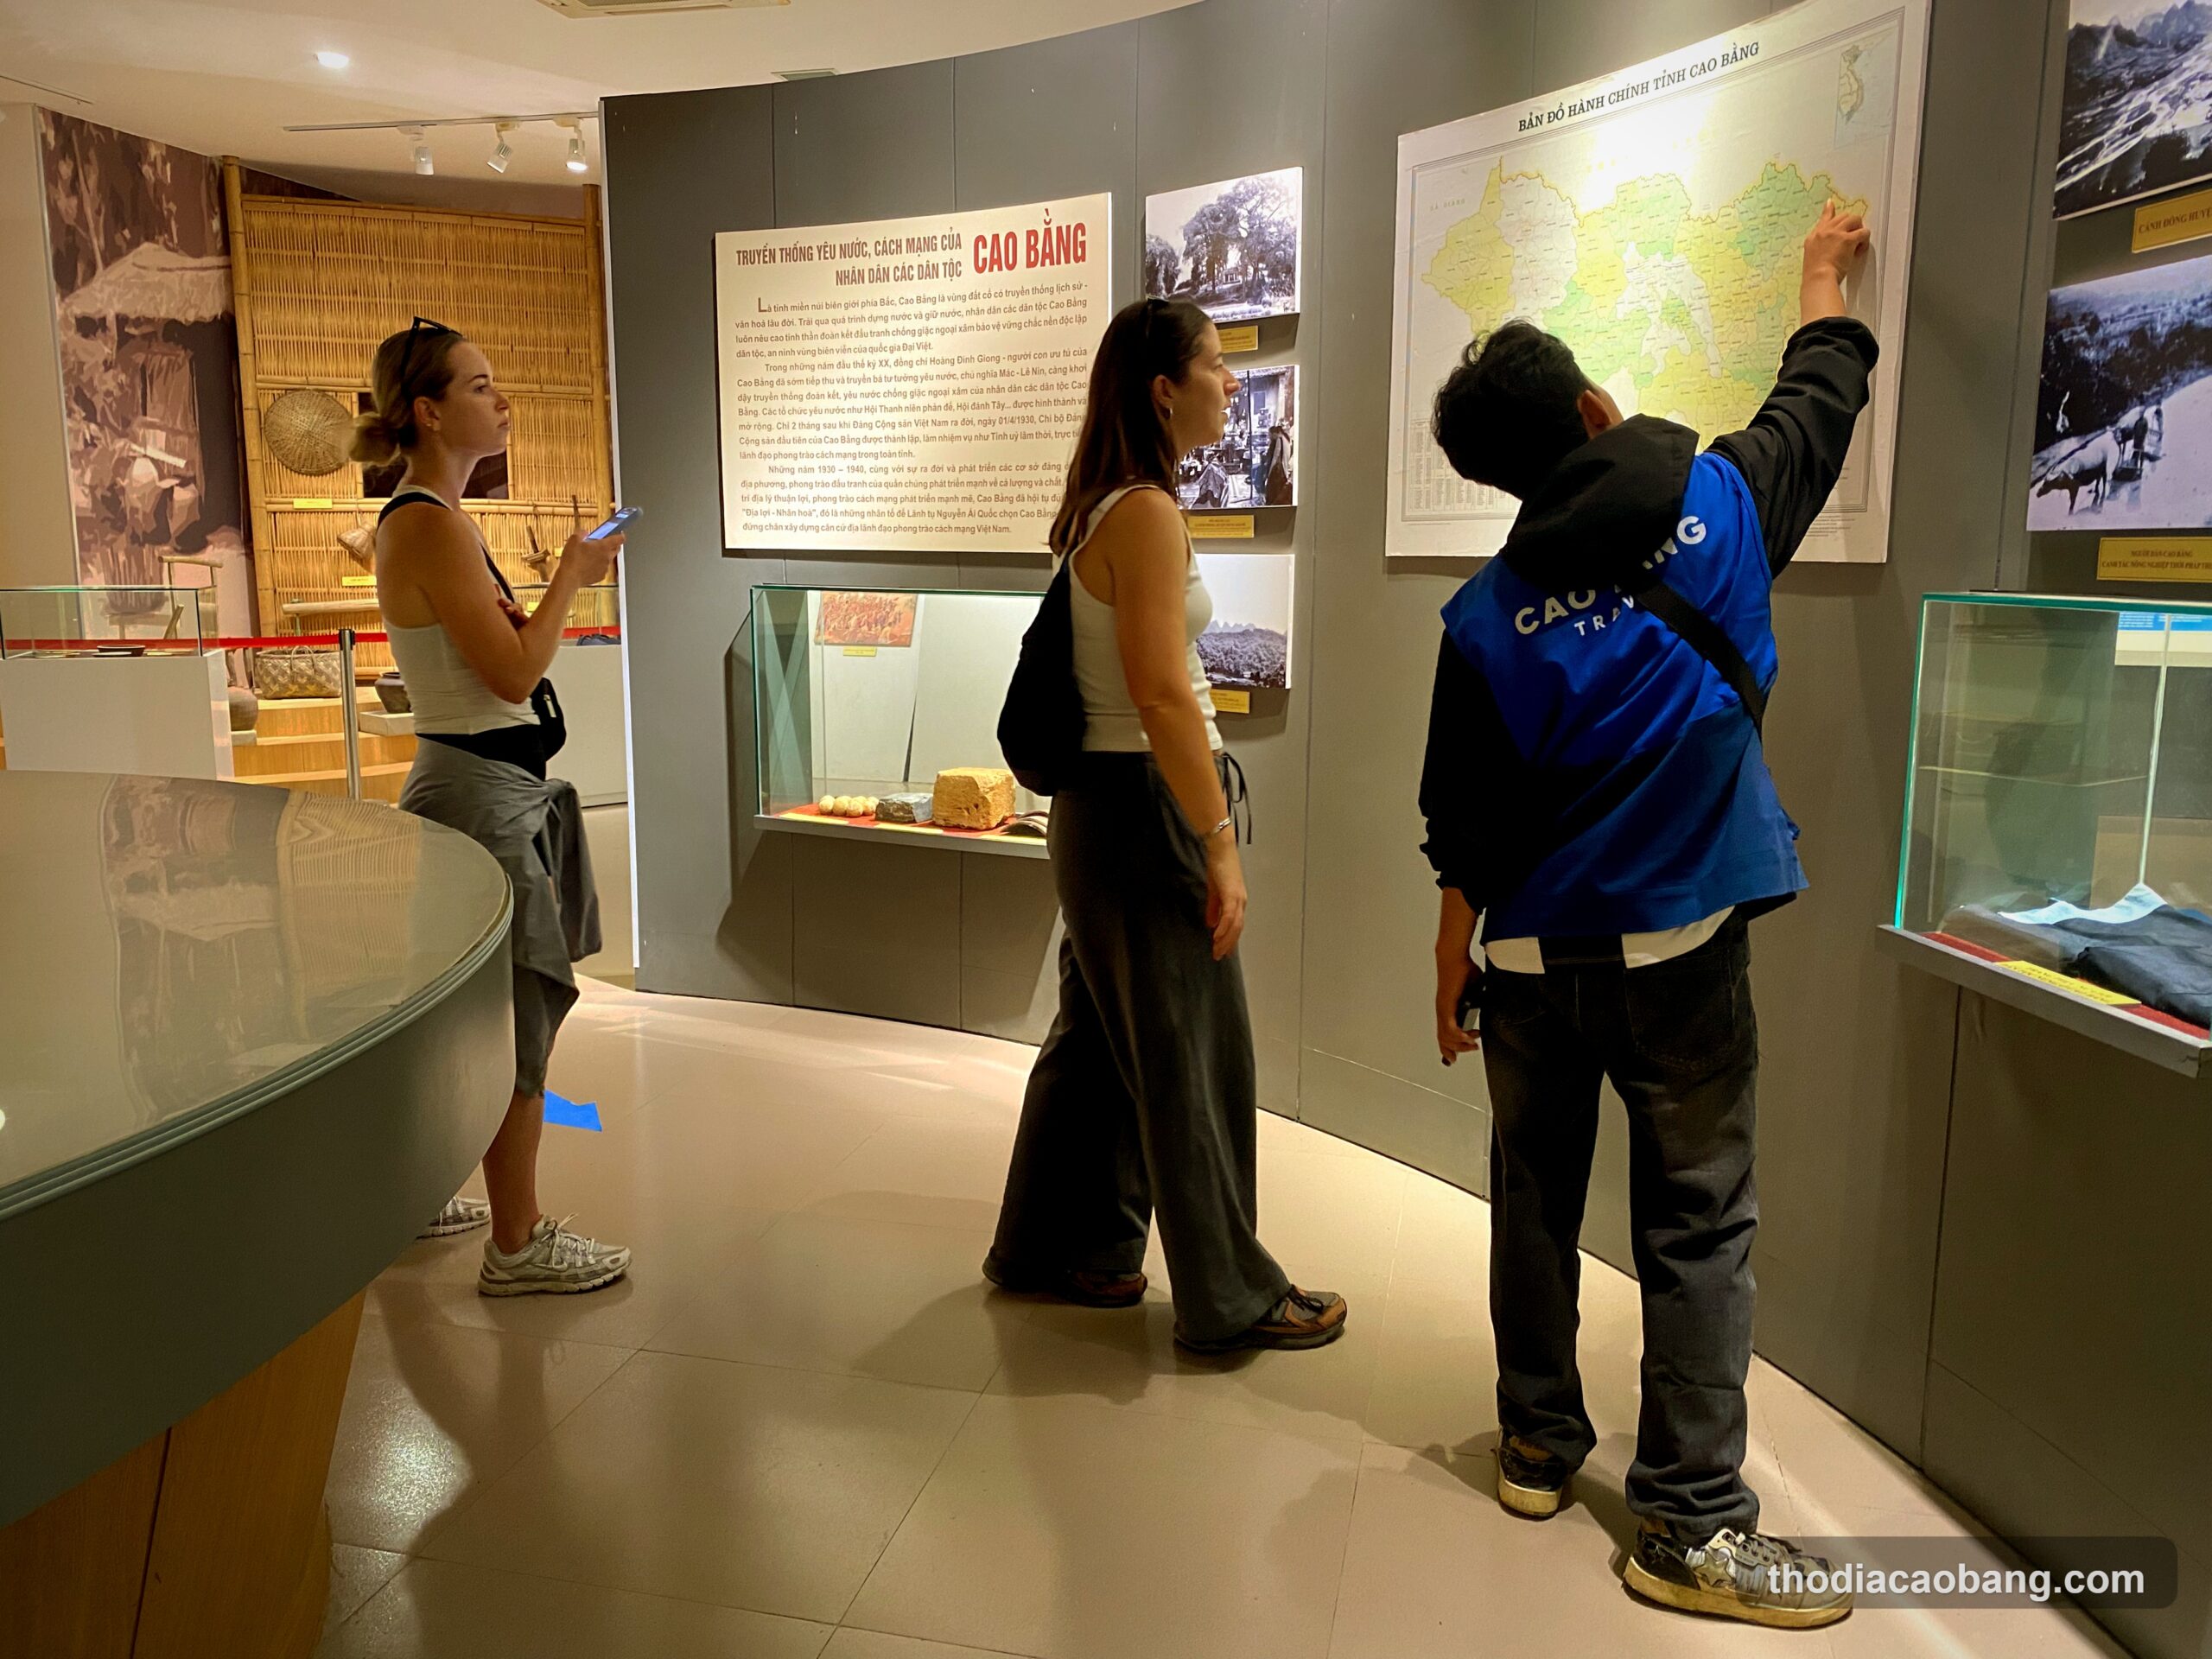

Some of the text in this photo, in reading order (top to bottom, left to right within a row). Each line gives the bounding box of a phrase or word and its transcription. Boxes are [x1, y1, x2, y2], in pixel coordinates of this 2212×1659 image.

[1518, 41, 1760, 132] BẢN ĐỒ HÀNH CHÍNH TỈNH CAO BẰNG
[736, 226, 962, 265] TRUYỀN THỐNG YÊU NƯỚC, CÁCH MẠNG CỦA
[974, 208, 1086, 274] CAO BẰNG
[836, 258, 962, 286] NHÂN DÂN CÁC DÂN TỘC
